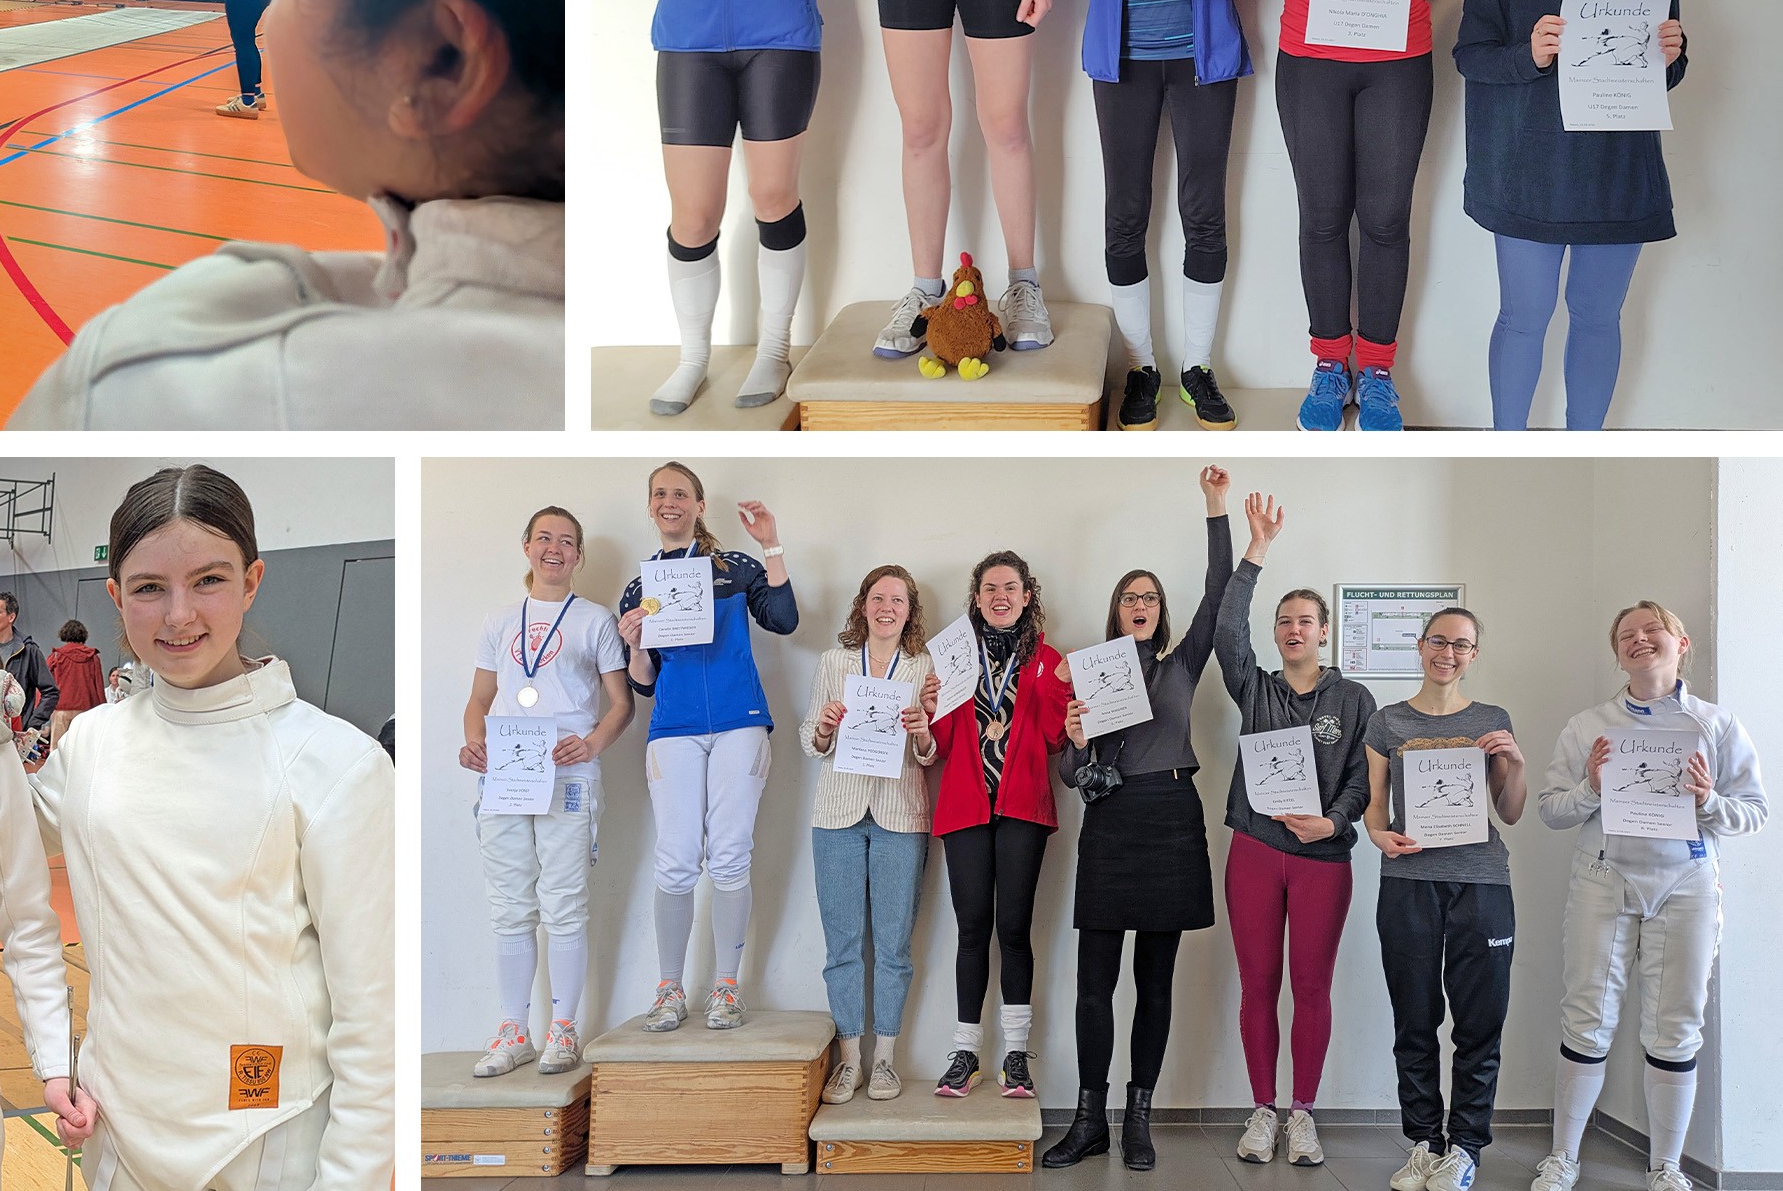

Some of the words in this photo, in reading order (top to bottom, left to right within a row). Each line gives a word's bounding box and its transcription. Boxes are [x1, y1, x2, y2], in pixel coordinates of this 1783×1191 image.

[1580, 1, 1651, 19] Urkunde
[655, 568, 701, 582] Urkunde
[938, 629, 968, 656] Urkunde
[1082, 649, 1126, 670] Urkunde
[857, 685, 901, 701] Urkunde
[499, 724, 547, 737] Urkunde
[1254, 736, 1301, 753] Urkunde
[1620, 739, 1683, 754] Urkunde
[1418, 758, 1472, 773] Urkunde
